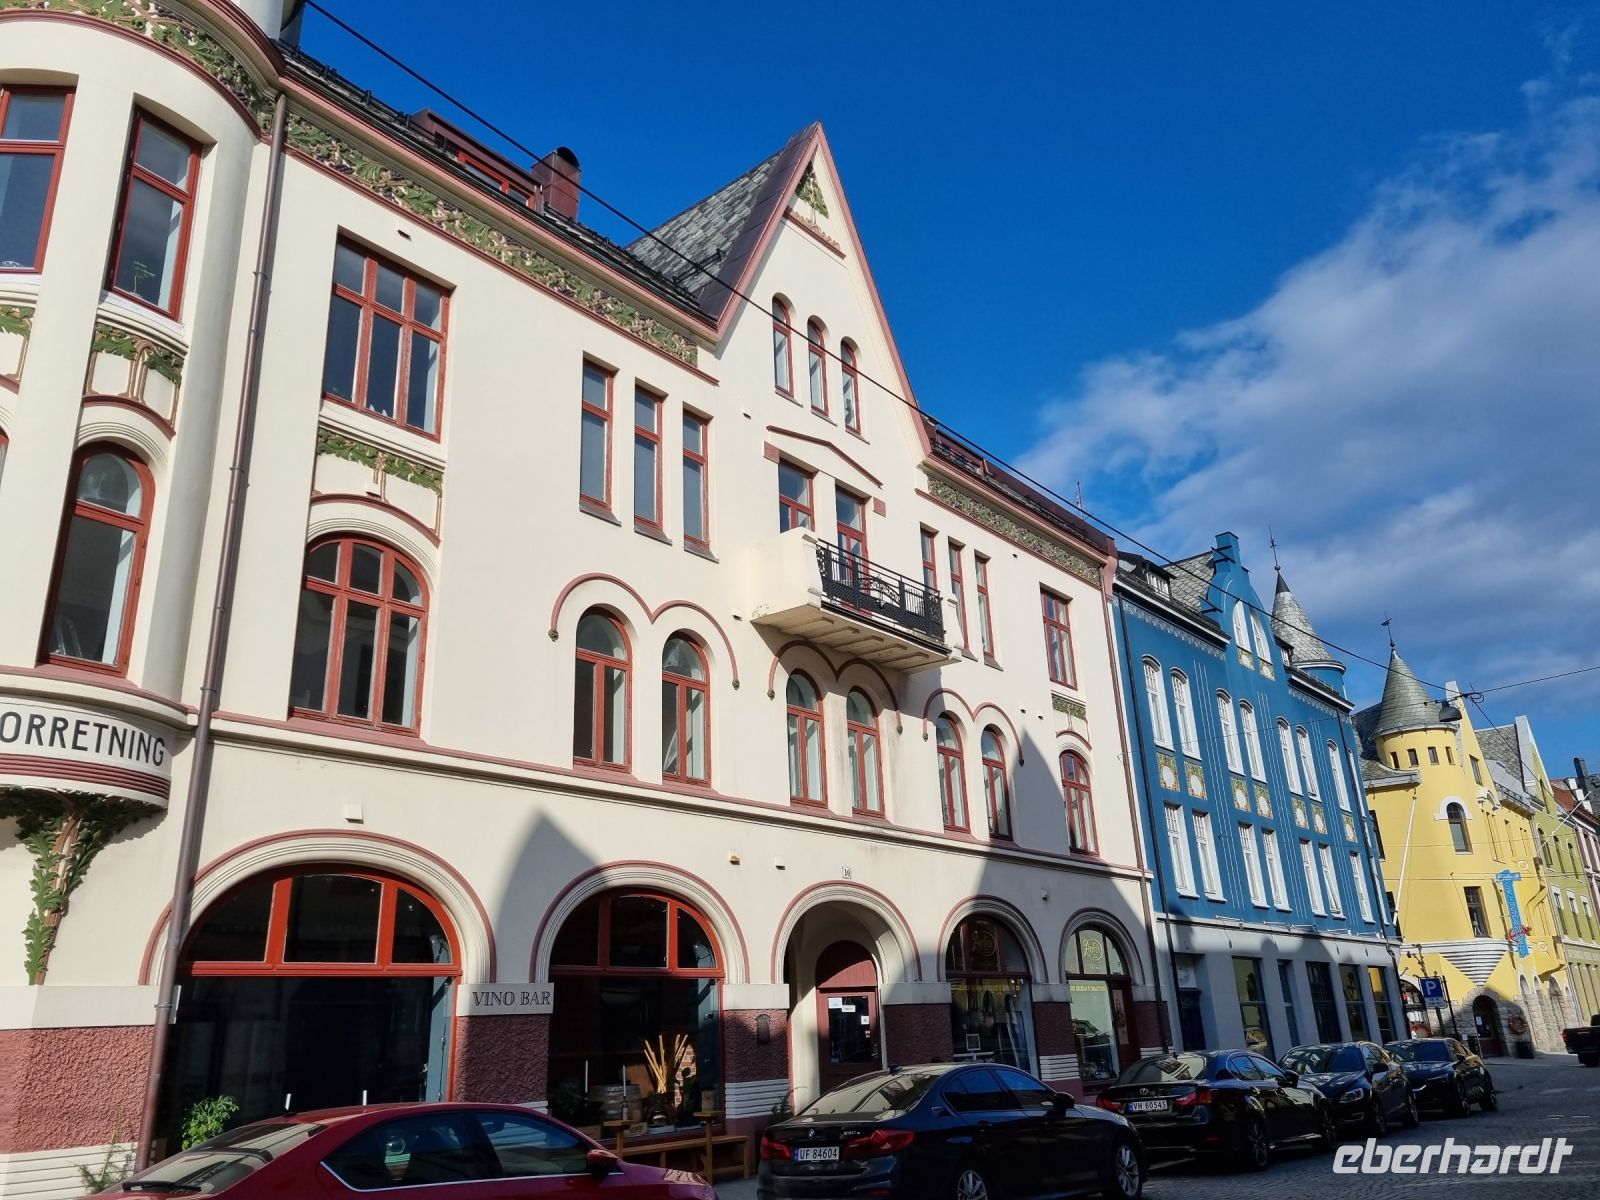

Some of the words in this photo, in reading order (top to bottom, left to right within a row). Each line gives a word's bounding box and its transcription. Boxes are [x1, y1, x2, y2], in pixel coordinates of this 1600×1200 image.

[0, 711, 166, 767] ORRETNING
[1425, 980, 1437, 996] P
[472, 991, 515, 1006] VINO
[520, 991, 551, 1005] BAR
[800, 1149, 811, 1160] UF
[812, 1148, 837, 1159] 84604
